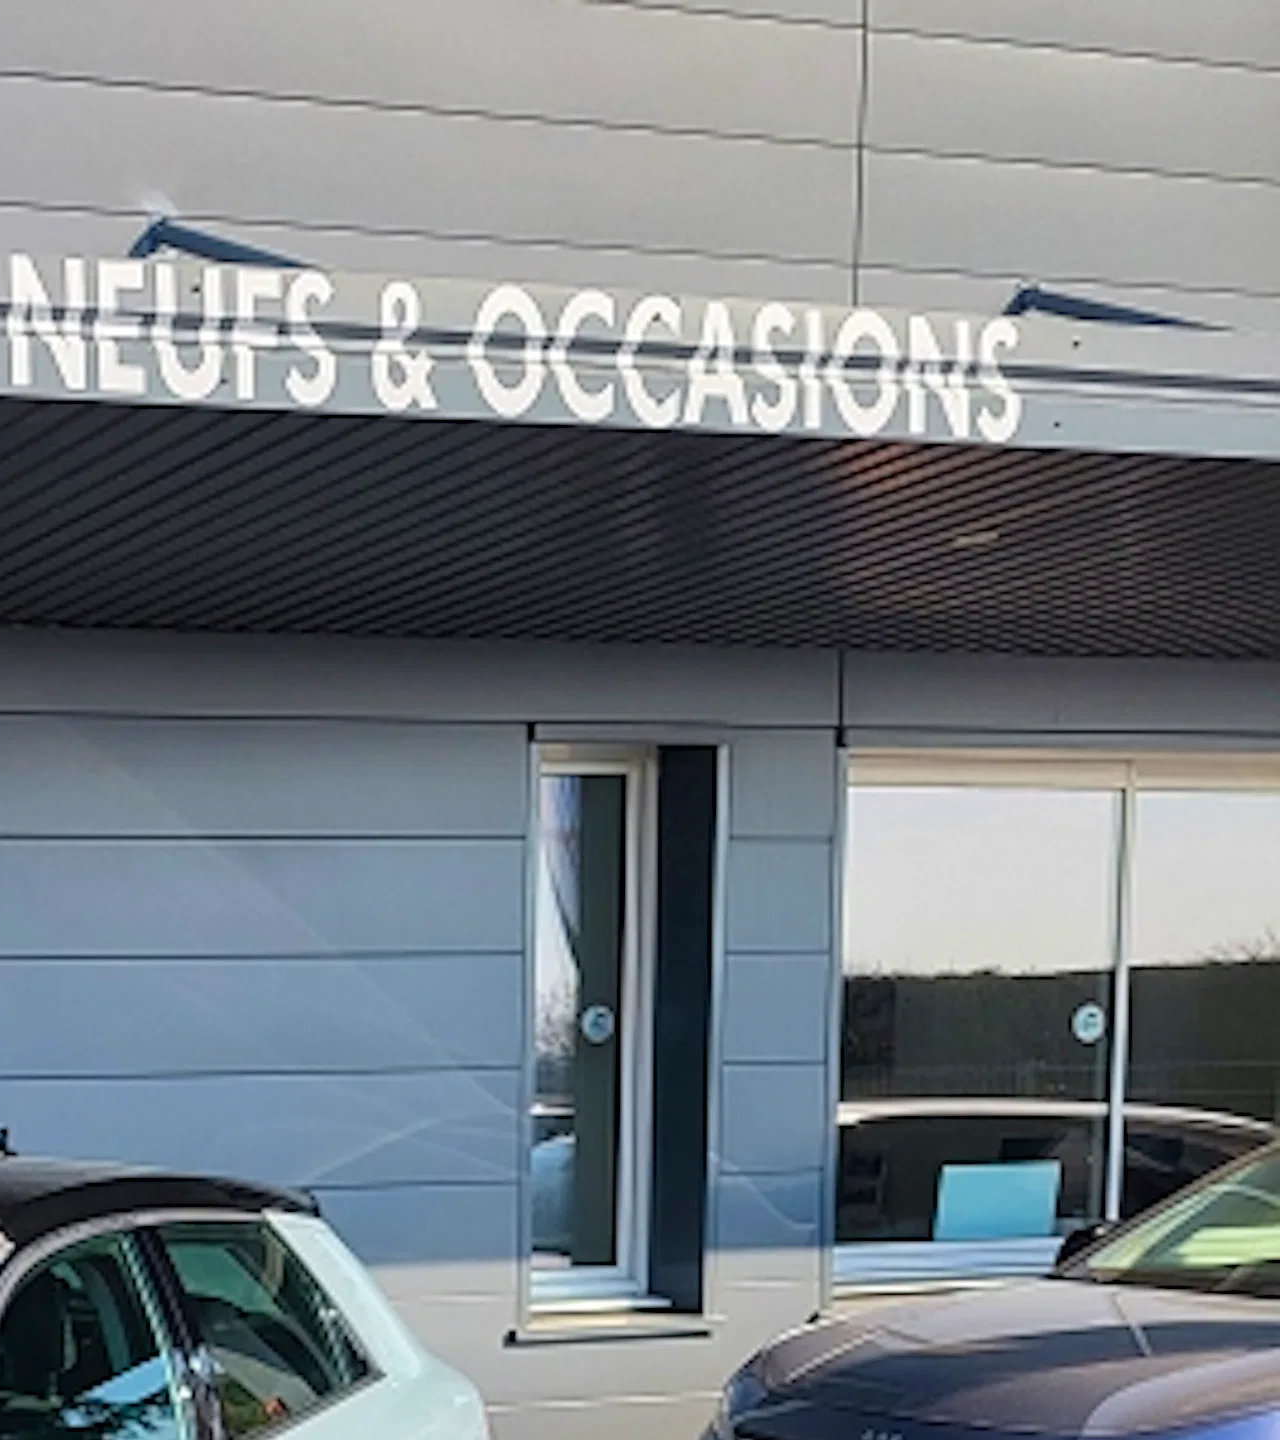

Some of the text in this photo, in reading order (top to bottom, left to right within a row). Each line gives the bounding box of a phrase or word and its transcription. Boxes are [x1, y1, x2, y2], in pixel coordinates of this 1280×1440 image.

[8, 252, 337, 407] NEUFS
[370, 281, 436, 413] &
[465, 284, 1022, 444] OCCASIONS
